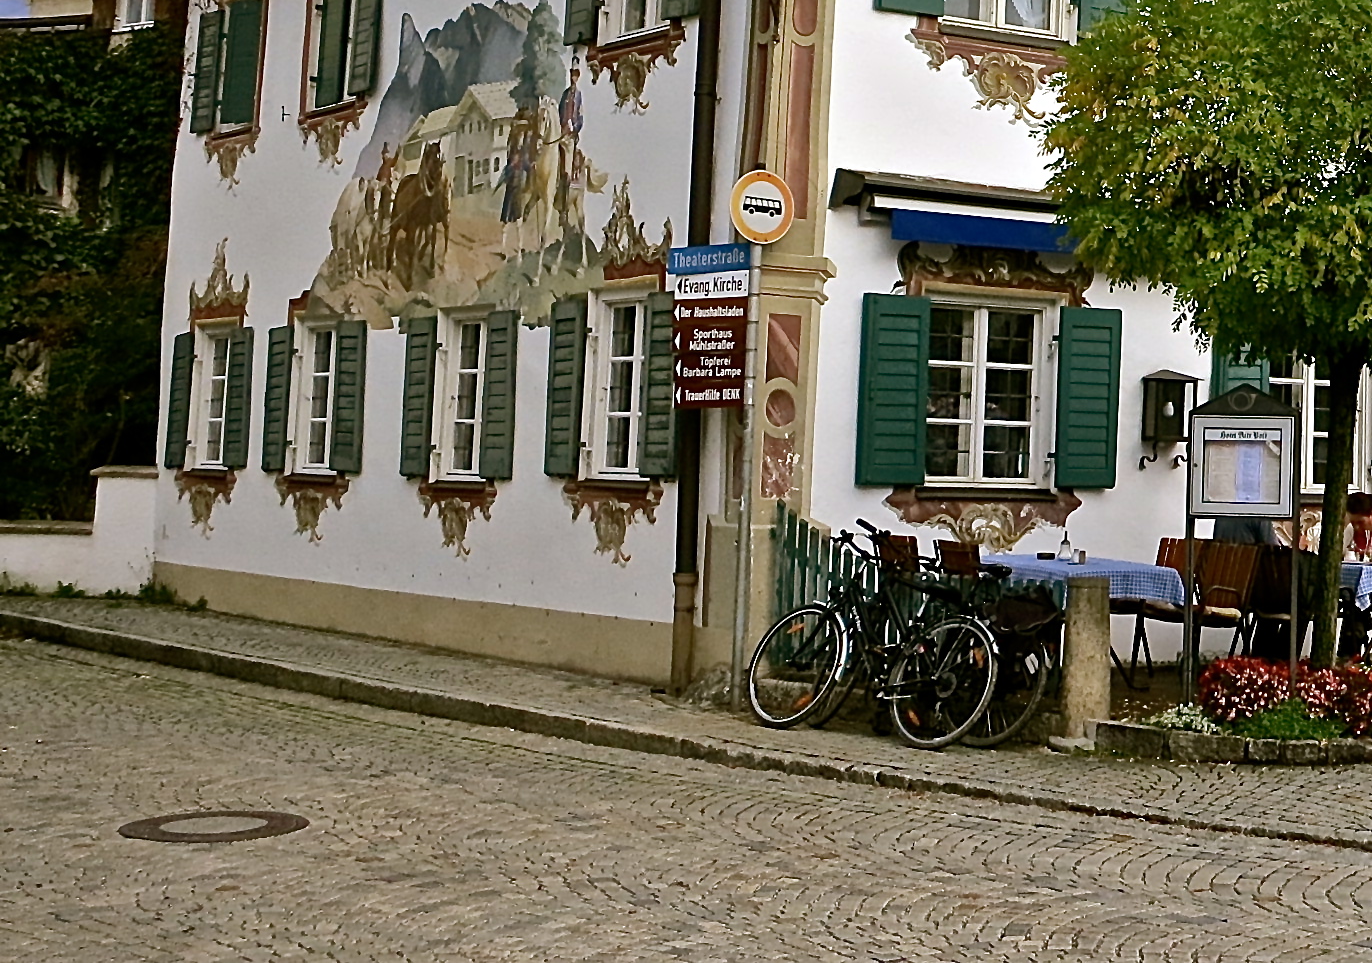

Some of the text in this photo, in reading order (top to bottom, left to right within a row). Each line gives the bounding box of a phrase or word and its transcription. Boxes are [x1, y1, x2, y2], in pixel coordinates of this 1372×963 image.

[673, 247, 745, 268] Theaterstraße
[683, 276, 743, 296] Evang. Kirche
[680, 305, 744, 318] Der Haushaltsladen
[693, 328, 733, 342] Sporthaus
[683, 366, 742, 379] Barbara Lampe
[722, 388, 741, 400] DENK
